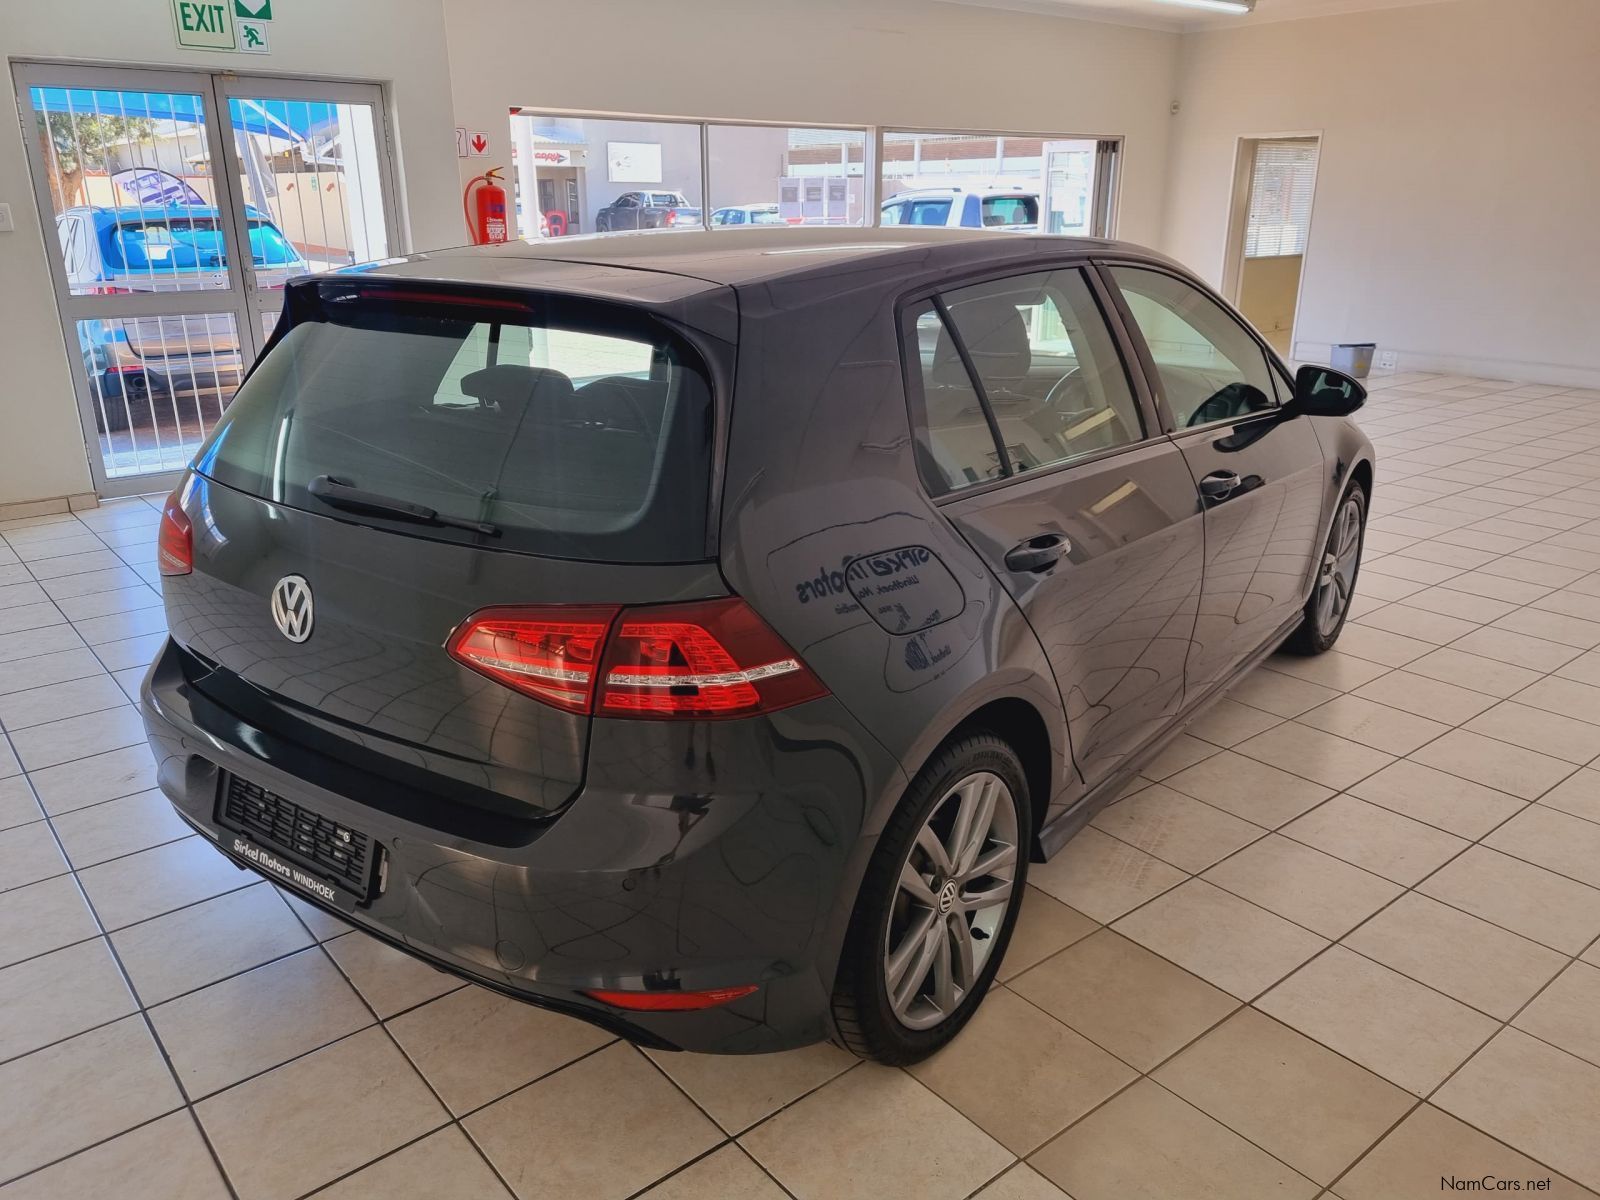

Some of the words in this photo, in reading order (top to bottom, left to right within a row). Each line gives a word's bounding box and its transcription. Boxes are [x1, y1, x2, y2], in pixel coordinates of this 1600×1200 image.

[180, 2, 224, 33] EXIT
[233, 839, 259, 861] Sirkel
[259, 852, 291, 877] Motors
[293, 869, 336, 902] WINDHOEK
